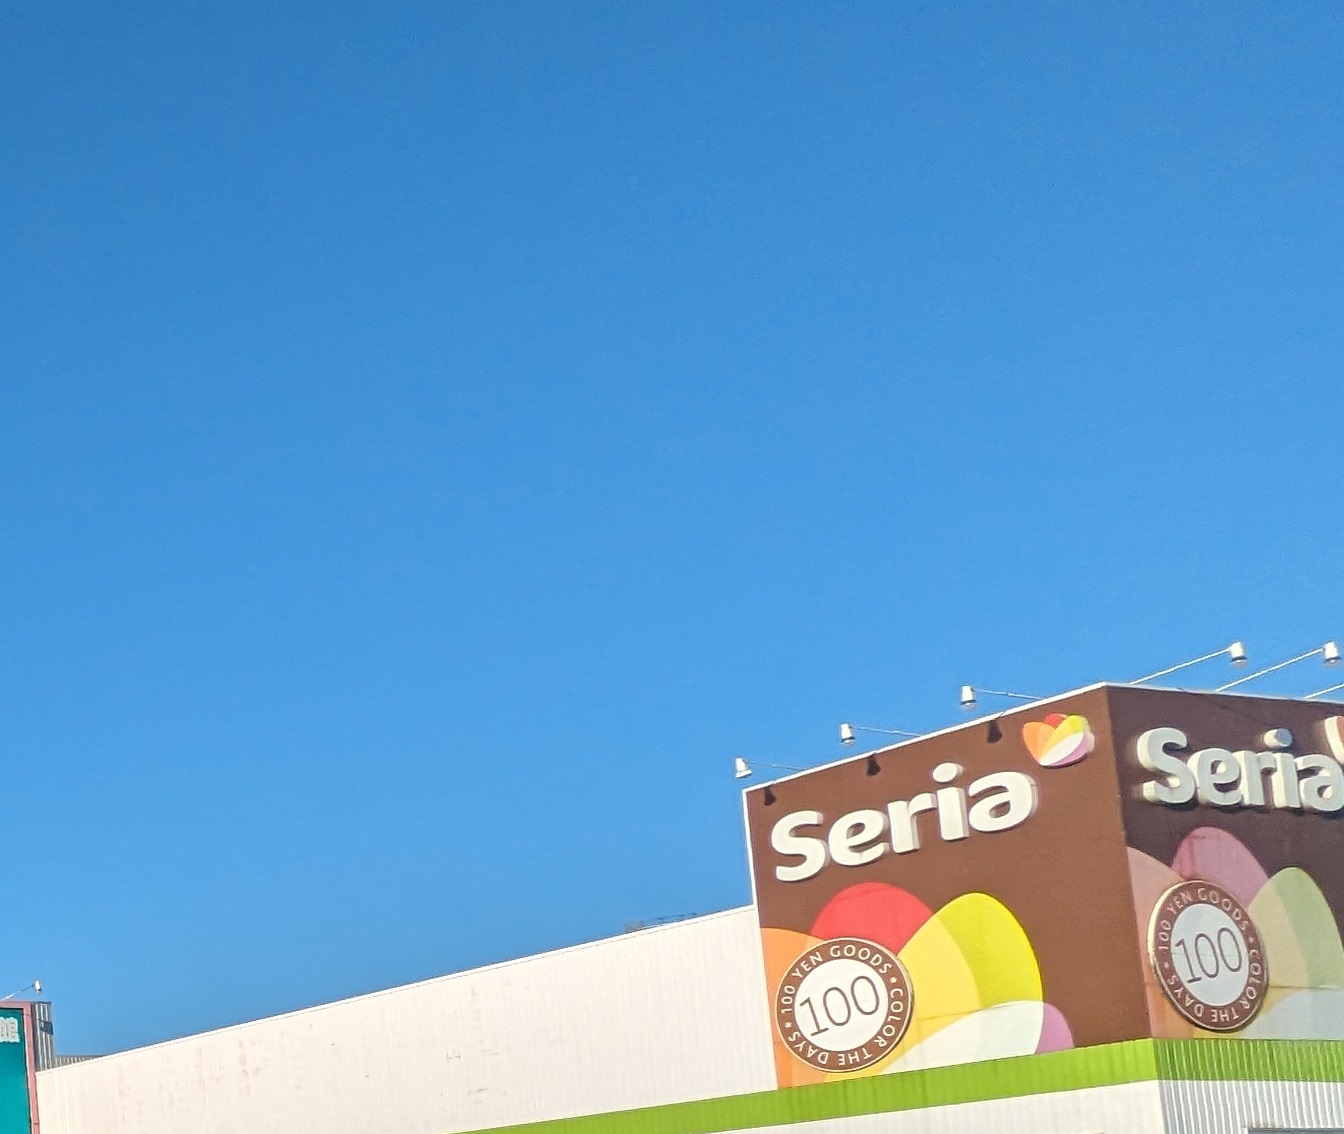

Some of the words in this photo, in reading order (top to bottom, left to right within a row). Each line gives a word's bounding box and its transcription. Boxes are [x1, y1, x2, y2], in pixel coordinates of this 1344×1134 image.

[1137, 727, 1344, 811] Seria
[771, 762, 1037, 882] Seria
[1167, 891, 1192, 915] YEN
[1197, 888, 1250, 931] GOODS
[781, 986, 795, 1014] 100
[792, 951, 823, 979] YEN
[830, 945, 892, 974] GOODS
[1175, 927, 1242, 984] 100
[799, 976, 880, 1036] 100
[874, 988, 904, 1047] COLOR
[1167, 975, 1205, 1017] DAYS
[1211, 1007, 1240, 1022] THE
[789, 1032, 829, 1064] DAYS
[838, 1048, 873, 1065] THE
